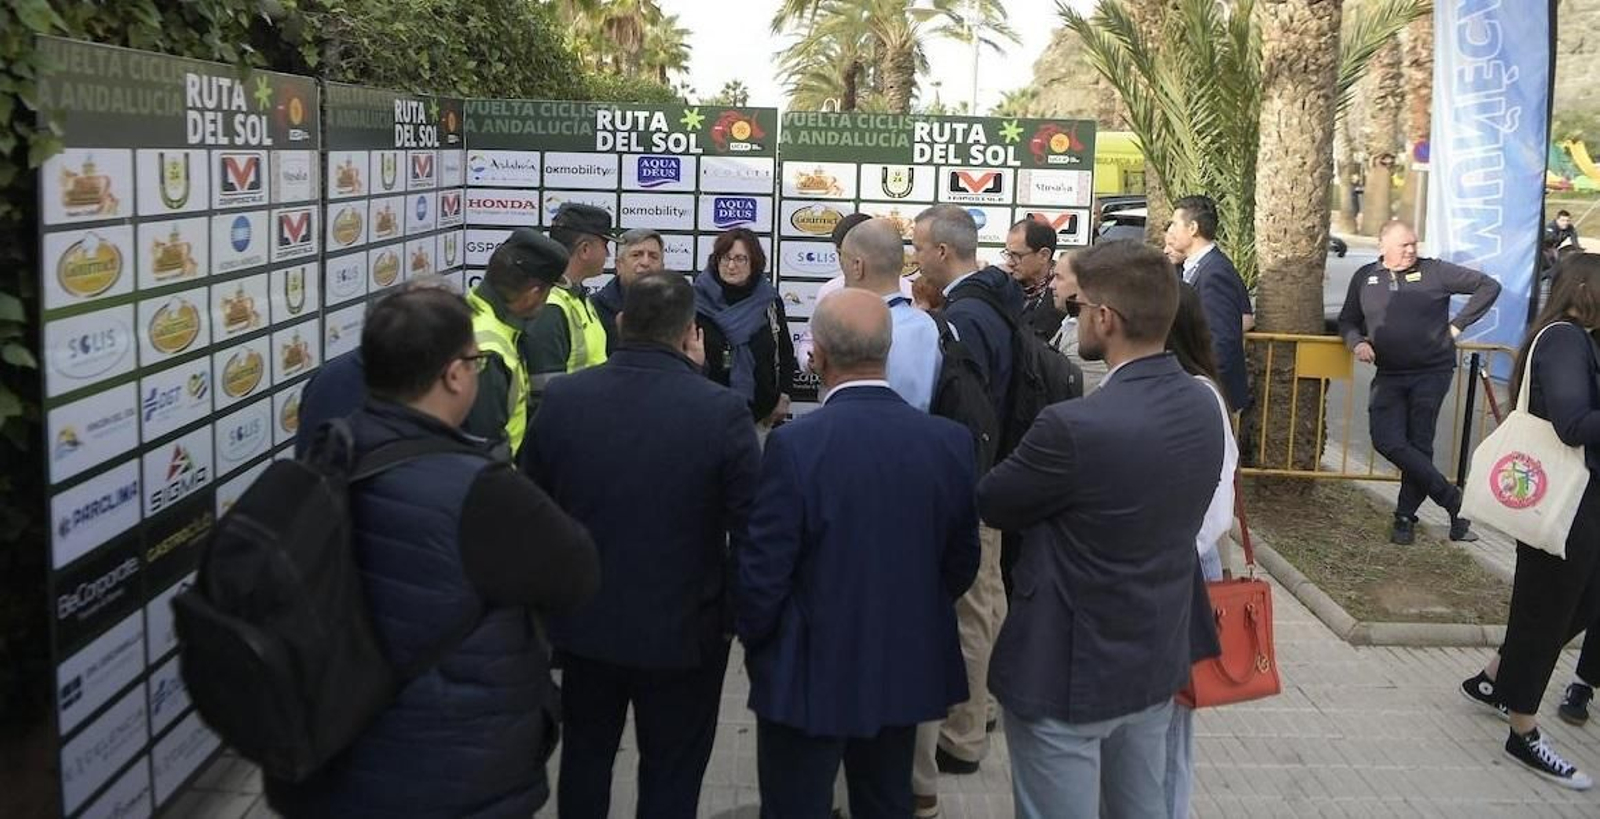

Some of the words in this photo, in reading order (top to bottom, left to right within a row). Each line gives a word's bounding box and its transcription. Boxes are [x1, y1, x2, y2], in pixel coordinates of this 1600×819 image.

[186, 72, 247, 111] RUTA
[395, 99, 426, 124] RUTA
[466, 101, 536, 117] VUELTA
[187, 110, 229, 145] DEL
[233, 116, 273, 147] SOL
[466, 119, 477, 133] A
[482, 118, 593, 135] ANDALUCÍA
[596, 109, 669, 131] RUTA
[783, 114, 852, 129] VUELTA
[395, 123, 418, 148] DEL
[419, 125, 440, 148] SOL
[596, 131, 645, 152] DEL
[652, 133, 703, 154] SOL
[782, 130, 793, 144] A
[798, 129, 910, 148] ANDALUCÍA
[914, 122, 987, 144] RUTA
[640, 160, 678, 169] AQUA
[913, 143, 962, 164] DEL
[969, 145, 1022, 167] SOL
[642, 168, 677, 178] DEUS
[467, 199, 537, 210] HONDA
[717, 199, 753, 209] AQUA
[719, 207, 752, 217] DEUS
